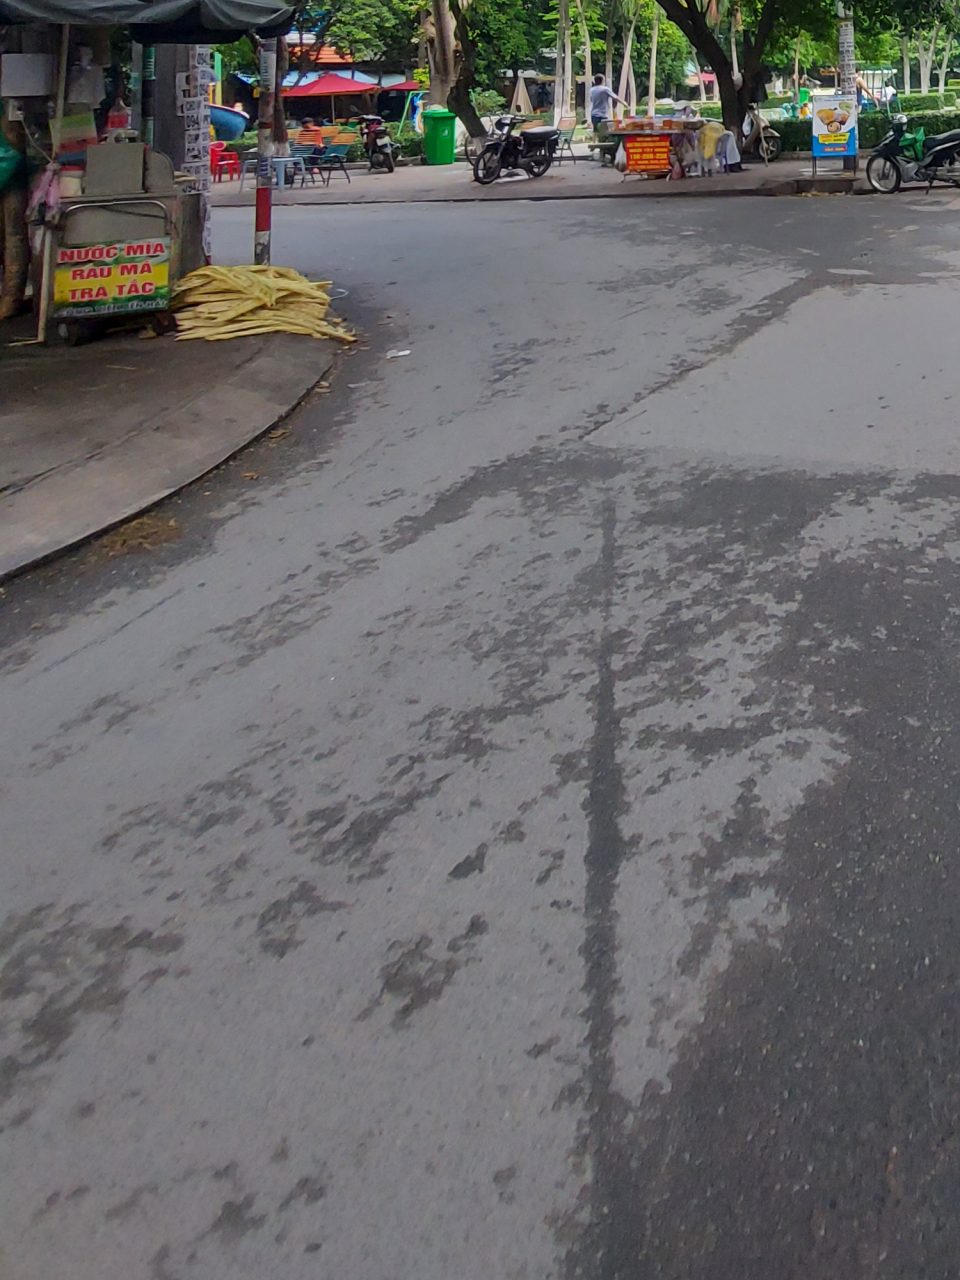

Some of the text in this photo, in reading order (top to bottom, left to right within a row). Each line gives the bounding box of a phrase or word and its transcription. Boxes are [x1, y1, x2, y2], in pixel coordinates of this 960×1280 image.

[60, 244, 118, 262] NƯỚC
[72, 260, 152, 281] RAU MÁ
[116, 279, 155, 296] TẮC
